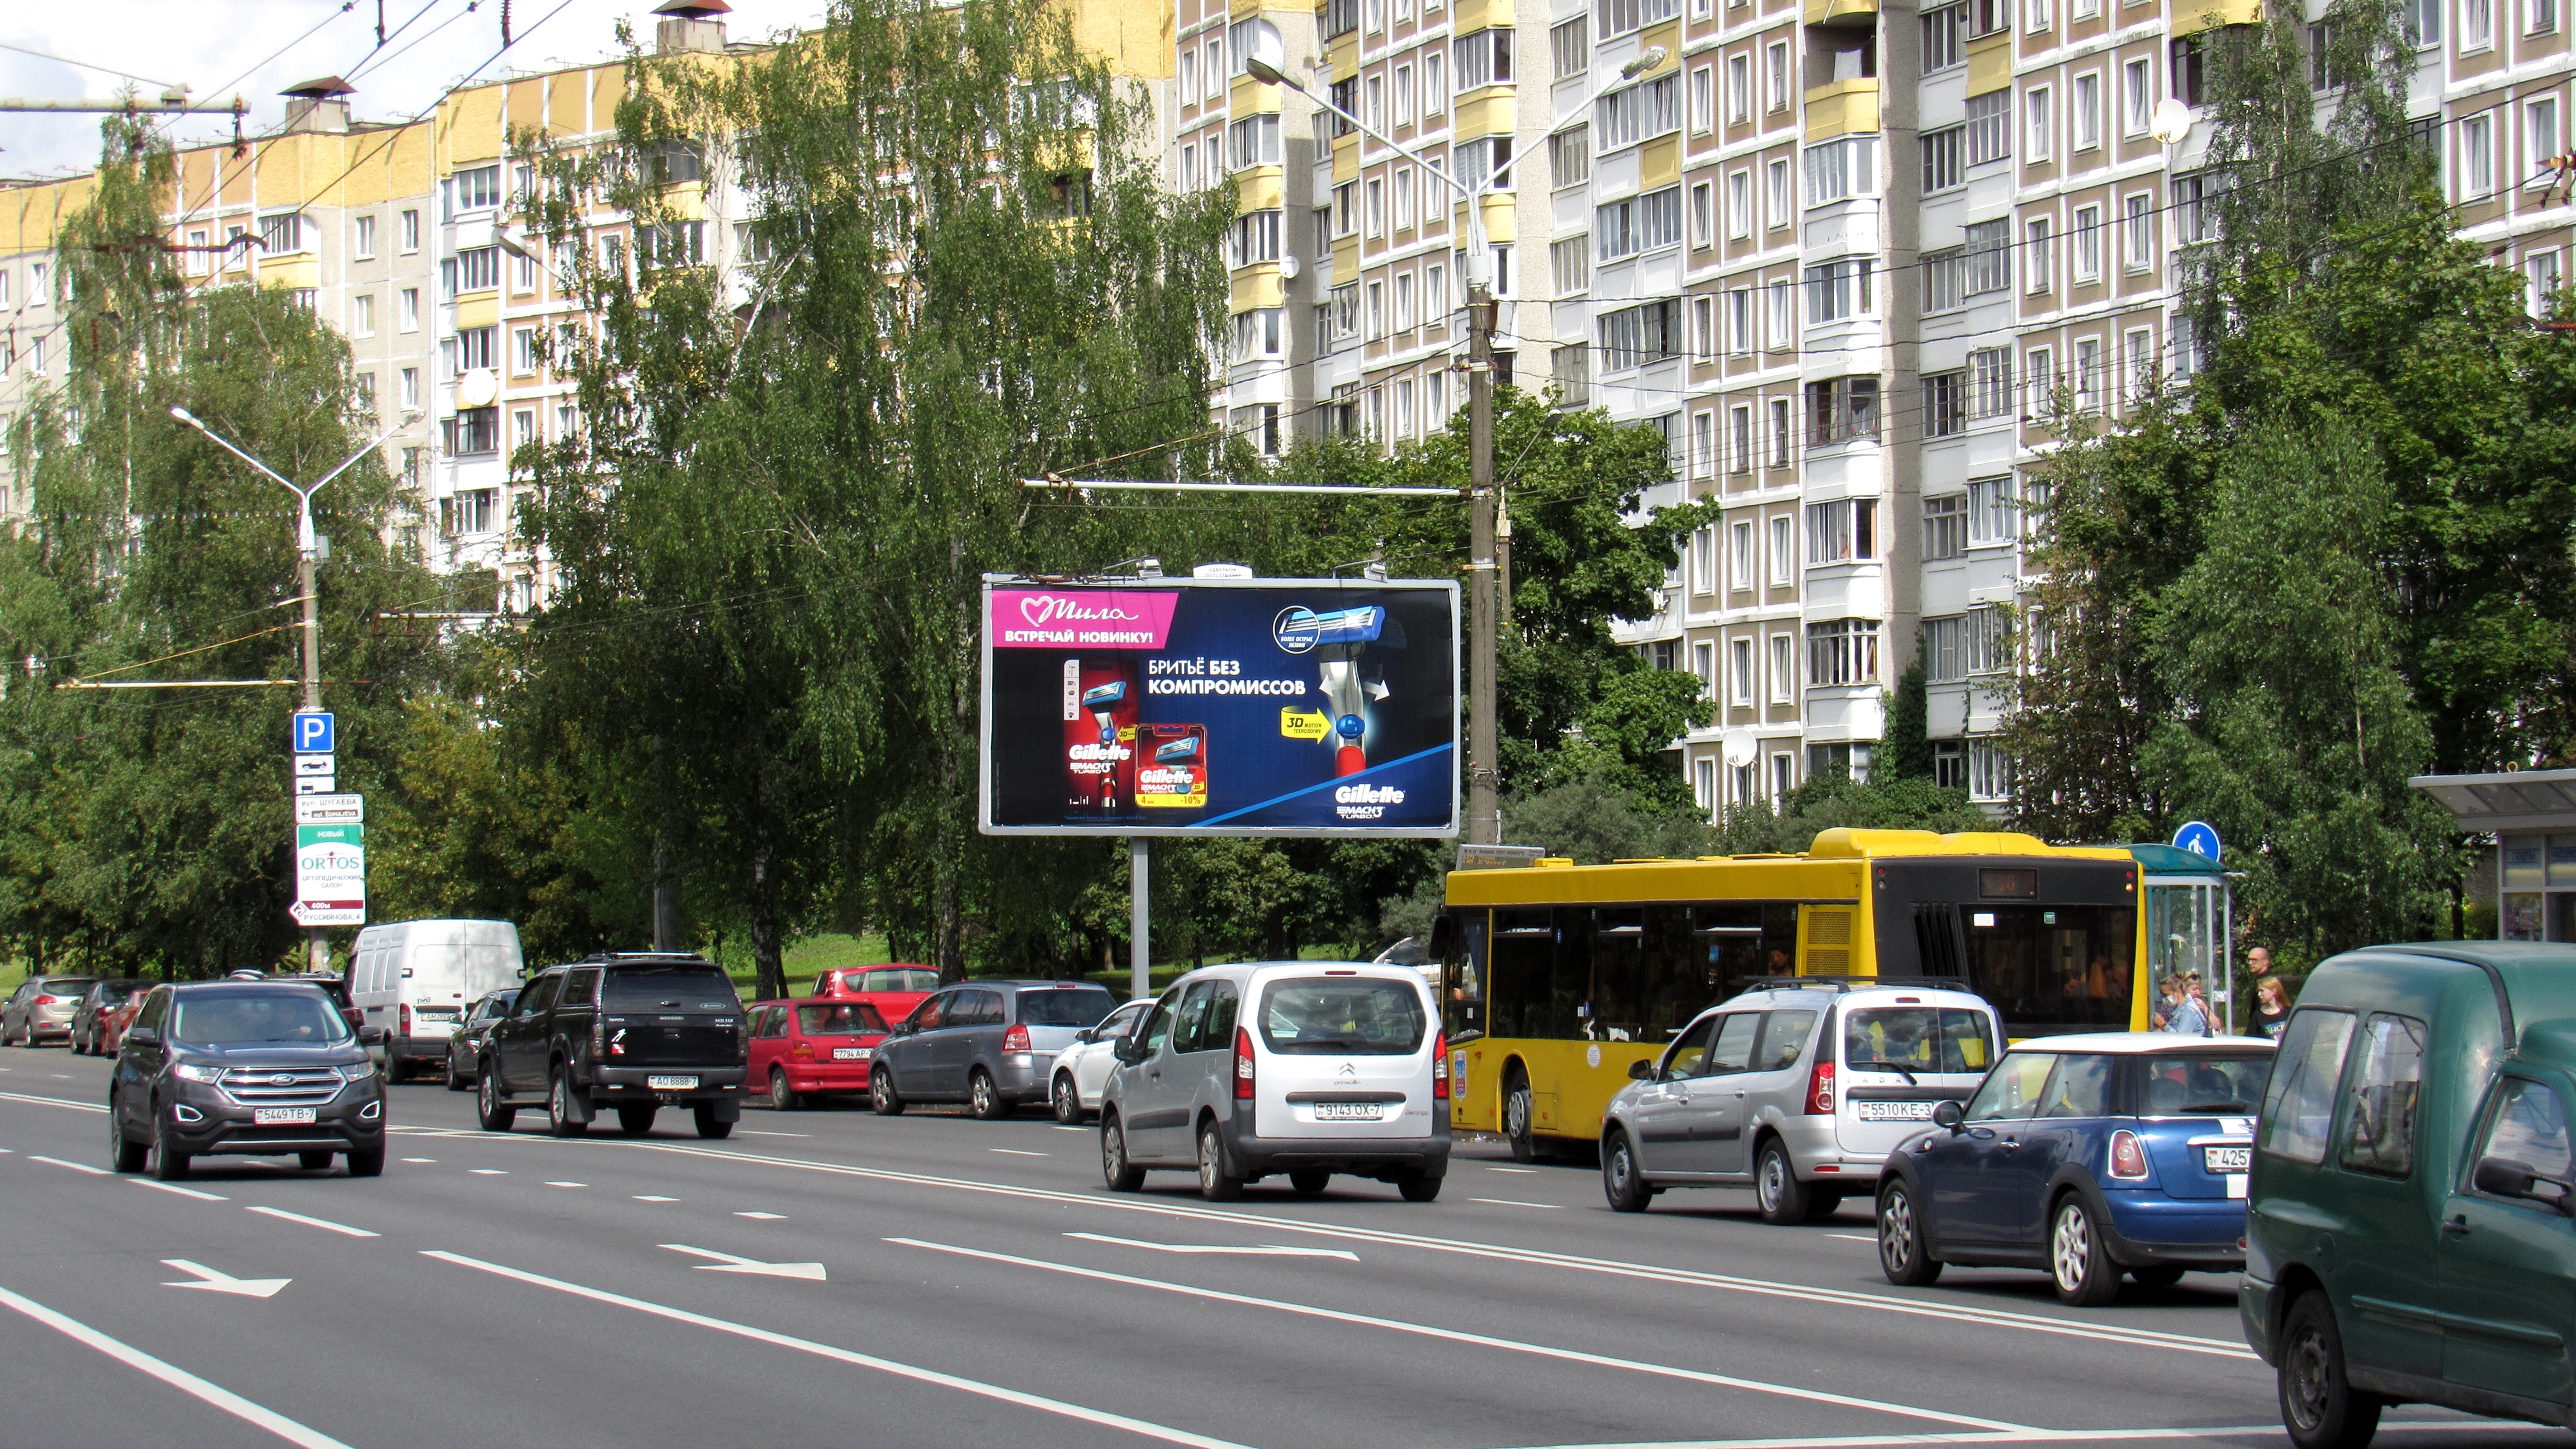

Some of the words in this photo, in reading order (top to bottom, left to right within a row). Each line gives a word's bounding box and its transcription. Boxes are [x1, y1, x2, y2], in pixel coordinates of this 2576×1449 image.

[1038, 598, 1139, 624] Мила
[1005, 628, 1074, 642] ВСТРЕЧАЙ
[1079, 631, 1153, 643] НОВИНКУ!
[1148, 656, 1205, 675] БРИТЬЁ
[1209, 660, 1240, 675] БЕЗ
[1148, 679, 1306, 695] КОМПРОМИССОВ
[1287, 717, 1304, 728] 3D
[304, 718, 325, 747] P
[1069, 744, 1130, 760] Gillette
[1140, 769, 1194, 784] Gillette
[1141, 795, 1146, 804] 4
[1335, 784, 1405, 804] Gillette
[301, 856, 360, 870] ORTOS
[839, 1049, 854, 1058] 7794
[657, 1077, 669, 1086] AO
[671, 1077, 697, 1086] 8888-7
[264, 1109, 288, 1120] 5449
[290, 1108, 315, 1119] TB-7
[1326, 1104, 1351, 1115] 9143
[1355, 1104, 1380, 1115] OX-7
[1871, 1104, 1899, 1116] 5510
[1901, 1104, 1931, 1116] KE-3
